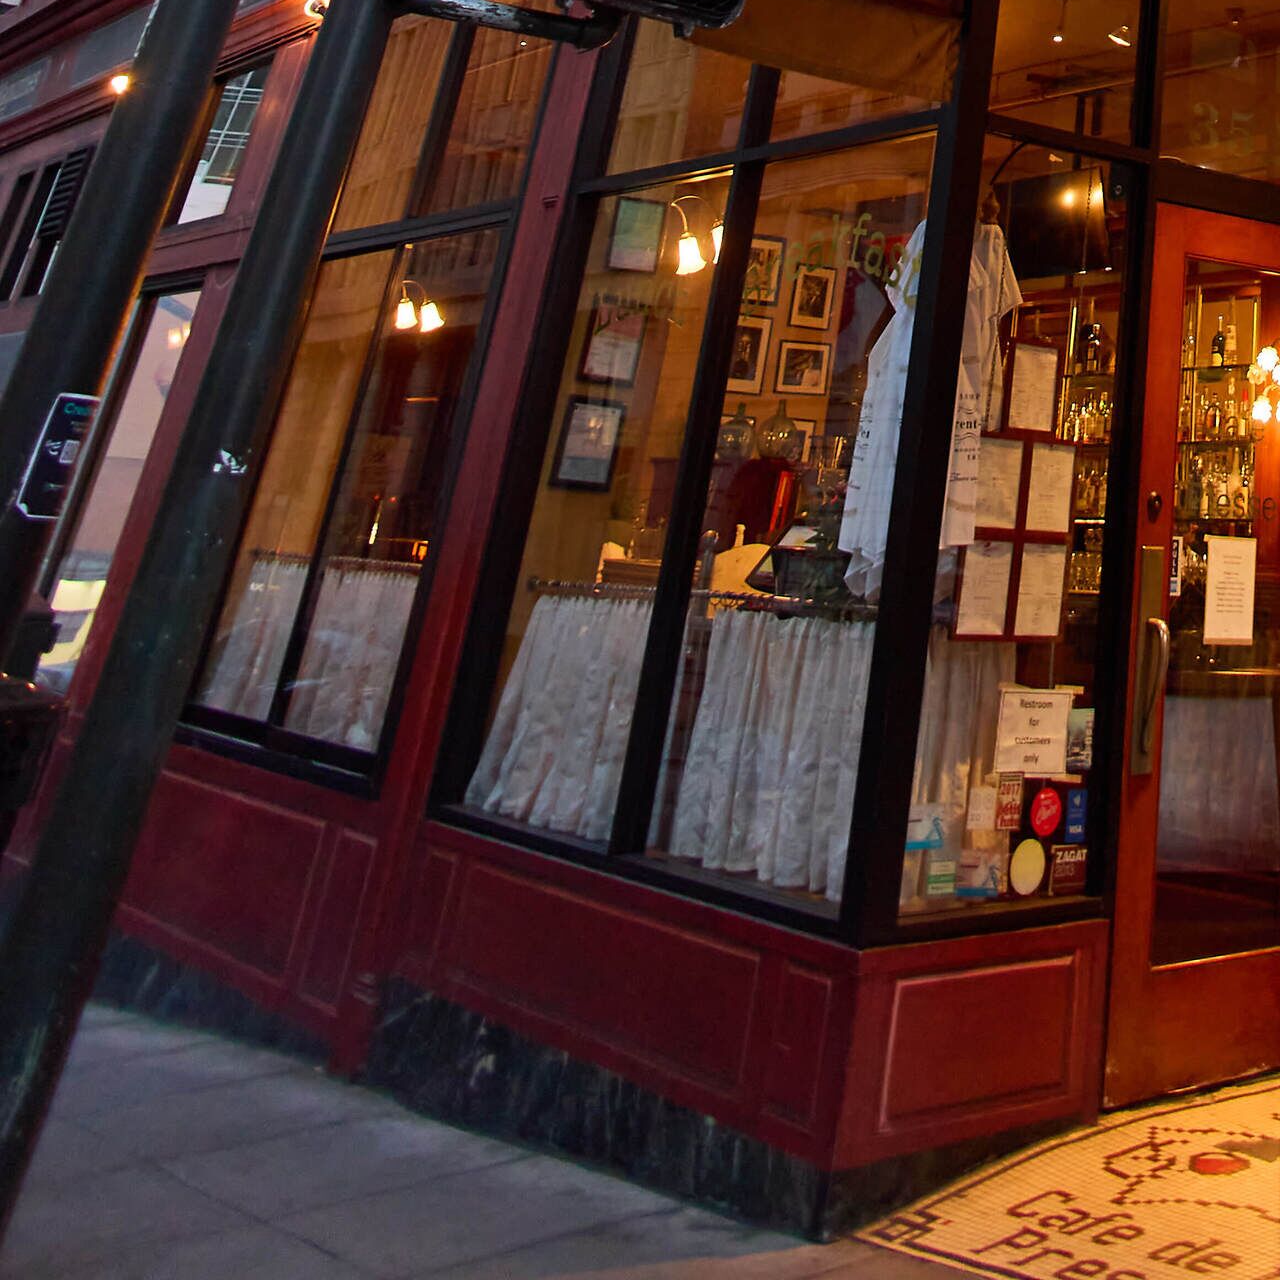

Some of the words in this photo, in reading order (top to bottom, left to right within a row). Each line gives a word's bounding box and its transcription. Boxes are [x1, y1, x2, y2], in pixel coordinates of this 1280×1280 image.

[1020, 698, 1054, 710] Restroom
[1028, 717, 1041, 727] for
[1023, 754, 1040, 767] only
[1056, 849, 1088, 864] ZAGAT
[1147, 1237, 1243, 1274] de
